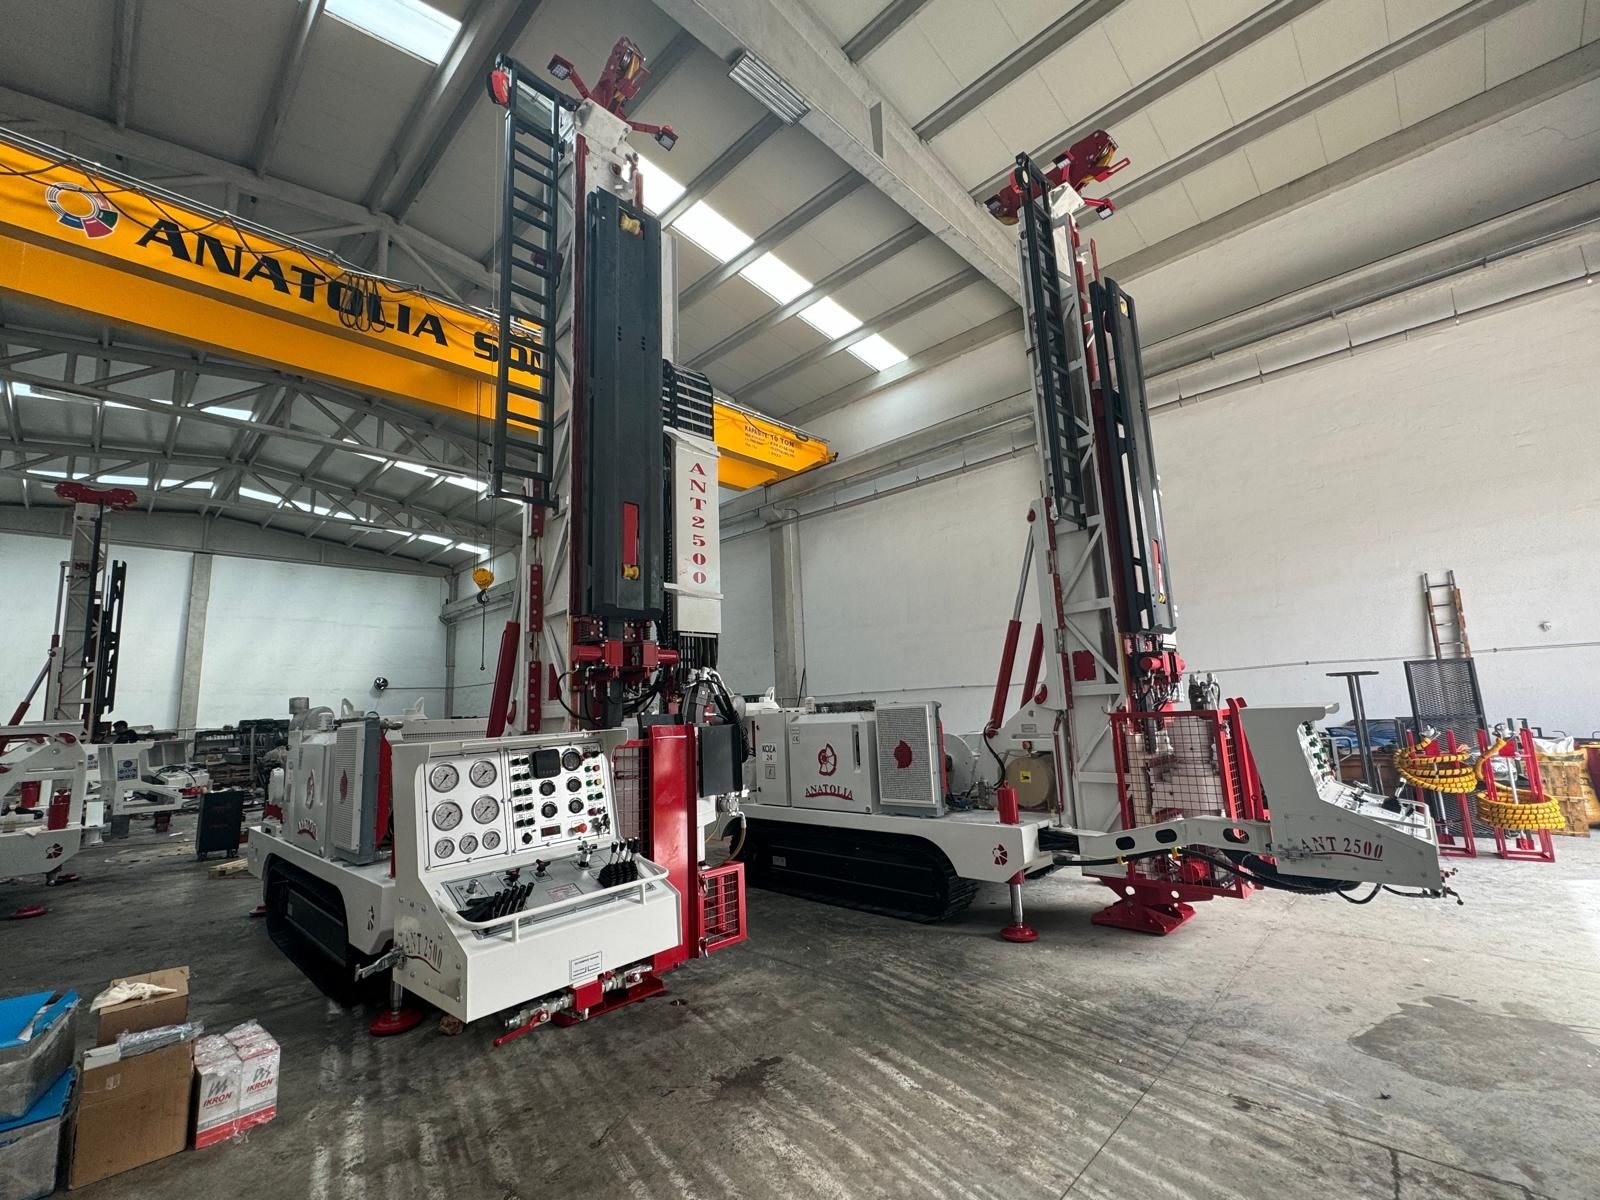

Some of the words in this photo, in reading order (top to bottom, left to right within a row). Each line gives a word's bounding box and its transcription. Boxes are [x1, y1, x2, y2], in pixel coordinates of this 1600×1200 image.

[136, 218, 448, 348] ANATOLIA
[780, 438, 795, 448] TON
[805, 784, 854, 800] ANATOLIA
[1301, 836, 1336, 853] ANT
[1343, 837, 1383, 859] 2500
[246, 1078, 273, 1093] IKRON
[203, 1091, 232, 1107] IKRON
